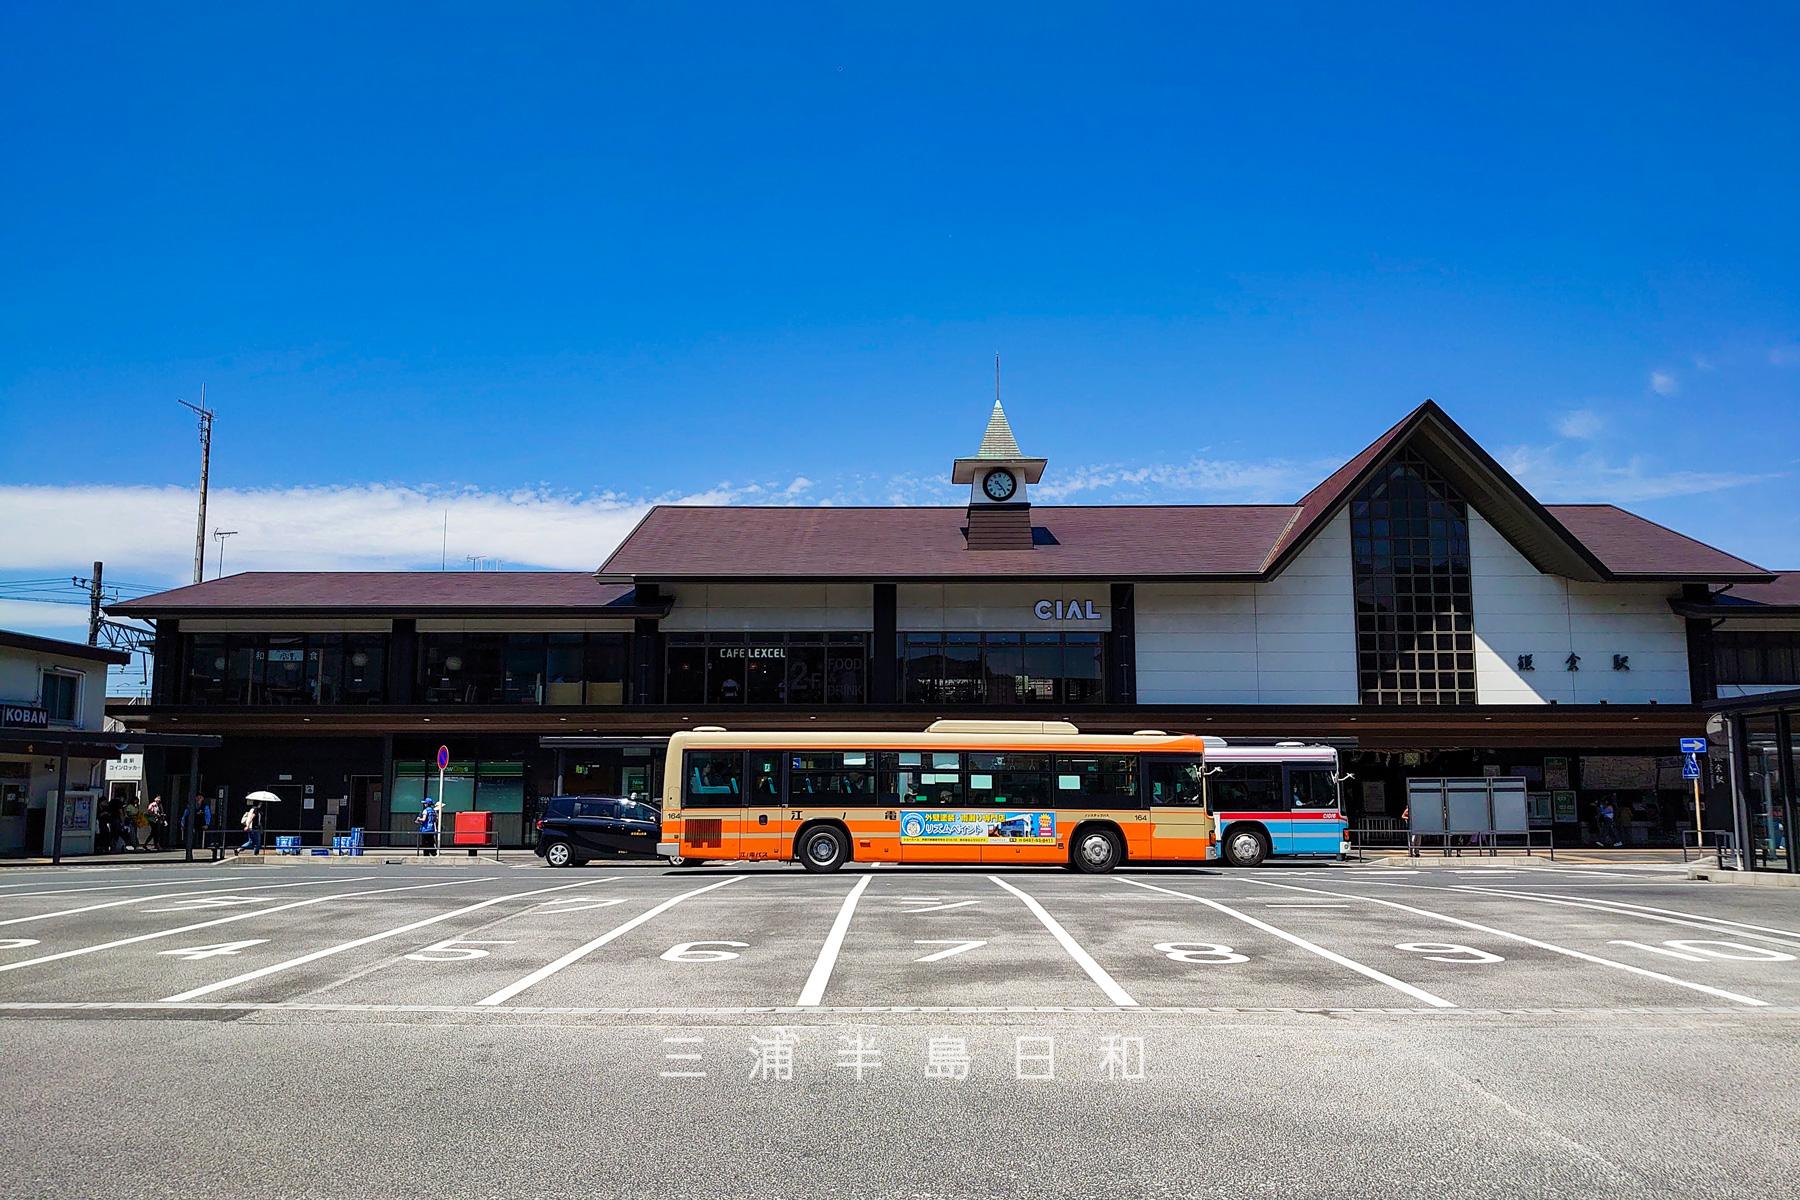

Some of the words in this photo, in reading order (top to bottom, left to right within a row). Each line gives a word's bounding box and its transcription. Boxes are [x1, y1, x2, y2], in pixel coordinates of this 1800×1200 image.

[1034, 599, 1102, 620] CIAL
[720, 648, 745, 658] CAFE
[748, 648, 786, 658] LEXCEL
[828, 658, 862, 670] FOOD
[827, 685, 863, 697] DRINK
[5, 707, 48, 725] KOBAN
[925, 823, 983, 835] リズムペイント
[156, 939, 272, 960] 4
[404, 939, 517, 962] 5
[660, 940, 751, 964] 6
[912, 940, 989, 963] 7
[1152, 941, 1252, 965] 8
[1394, 942, 1506, 965] 9
[1606, 939, 1797, 962] 10
